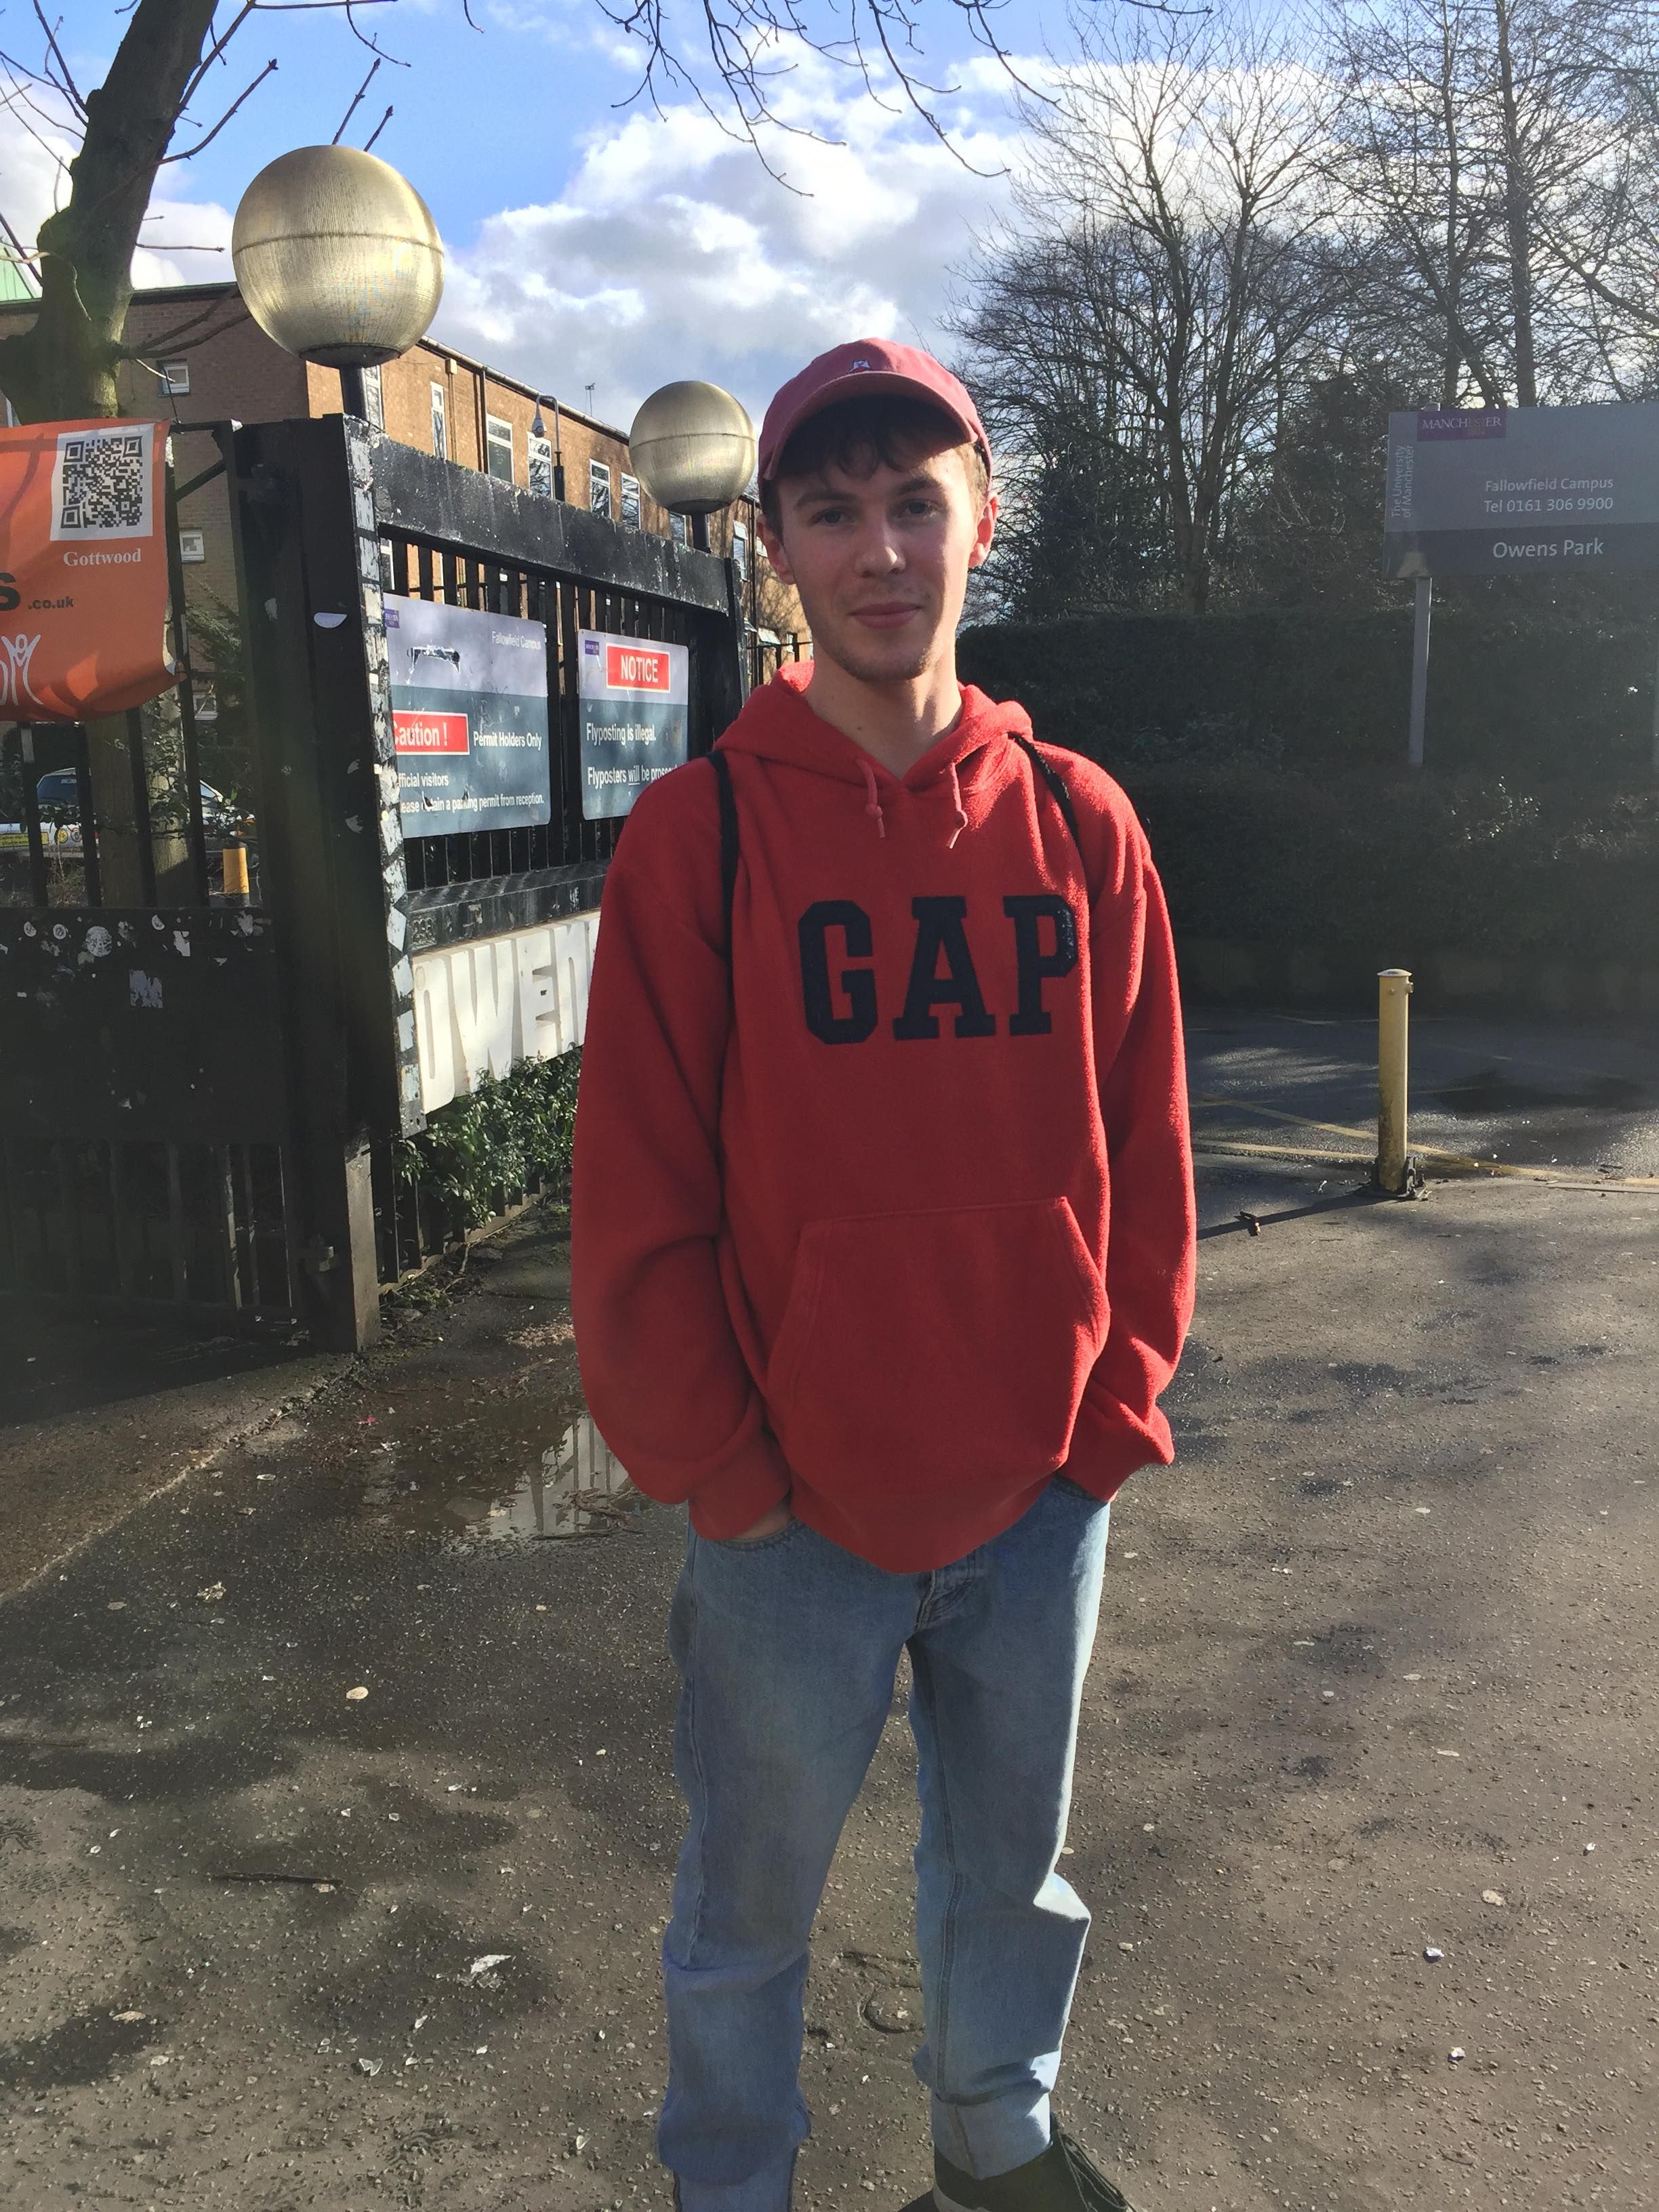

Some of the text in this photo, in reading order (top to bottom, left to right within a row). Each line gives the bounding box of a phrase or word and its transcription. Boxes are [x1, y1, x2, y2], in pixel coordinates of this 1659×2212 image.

[1422, 417, 1502, 429] MANCHSER
[1486, 478, 1614, 492] Fallowfield Campus
[1484, 497, 1613, 512] Tel 0161 306 9900
[63, 548, 142, 567] Gottwood
[1493, 537, 1604, 558] Owens Park
[621, 655, 659, 683] NOTICE
[473, 731, 542, 751] Permit Holders Only
[586, 722, 657, 745] Flyposting is illegal.
[398, 772, 449, 787] fficial visitors
[588, 766, 627, 790] Flyposters
[628, 765, 640, 783] will
[641, 765, 650, 781] be
[401, 801, 419, 813] ease
[421, 797, 445, 812] otain
[446, 800, 451, 811] a
[479, 794, 500, 812] permit
[501, 793, 515, 806] from
[798, 895, 1078, 1045] GAP
[412, 915, 602, 1115] OWEN
